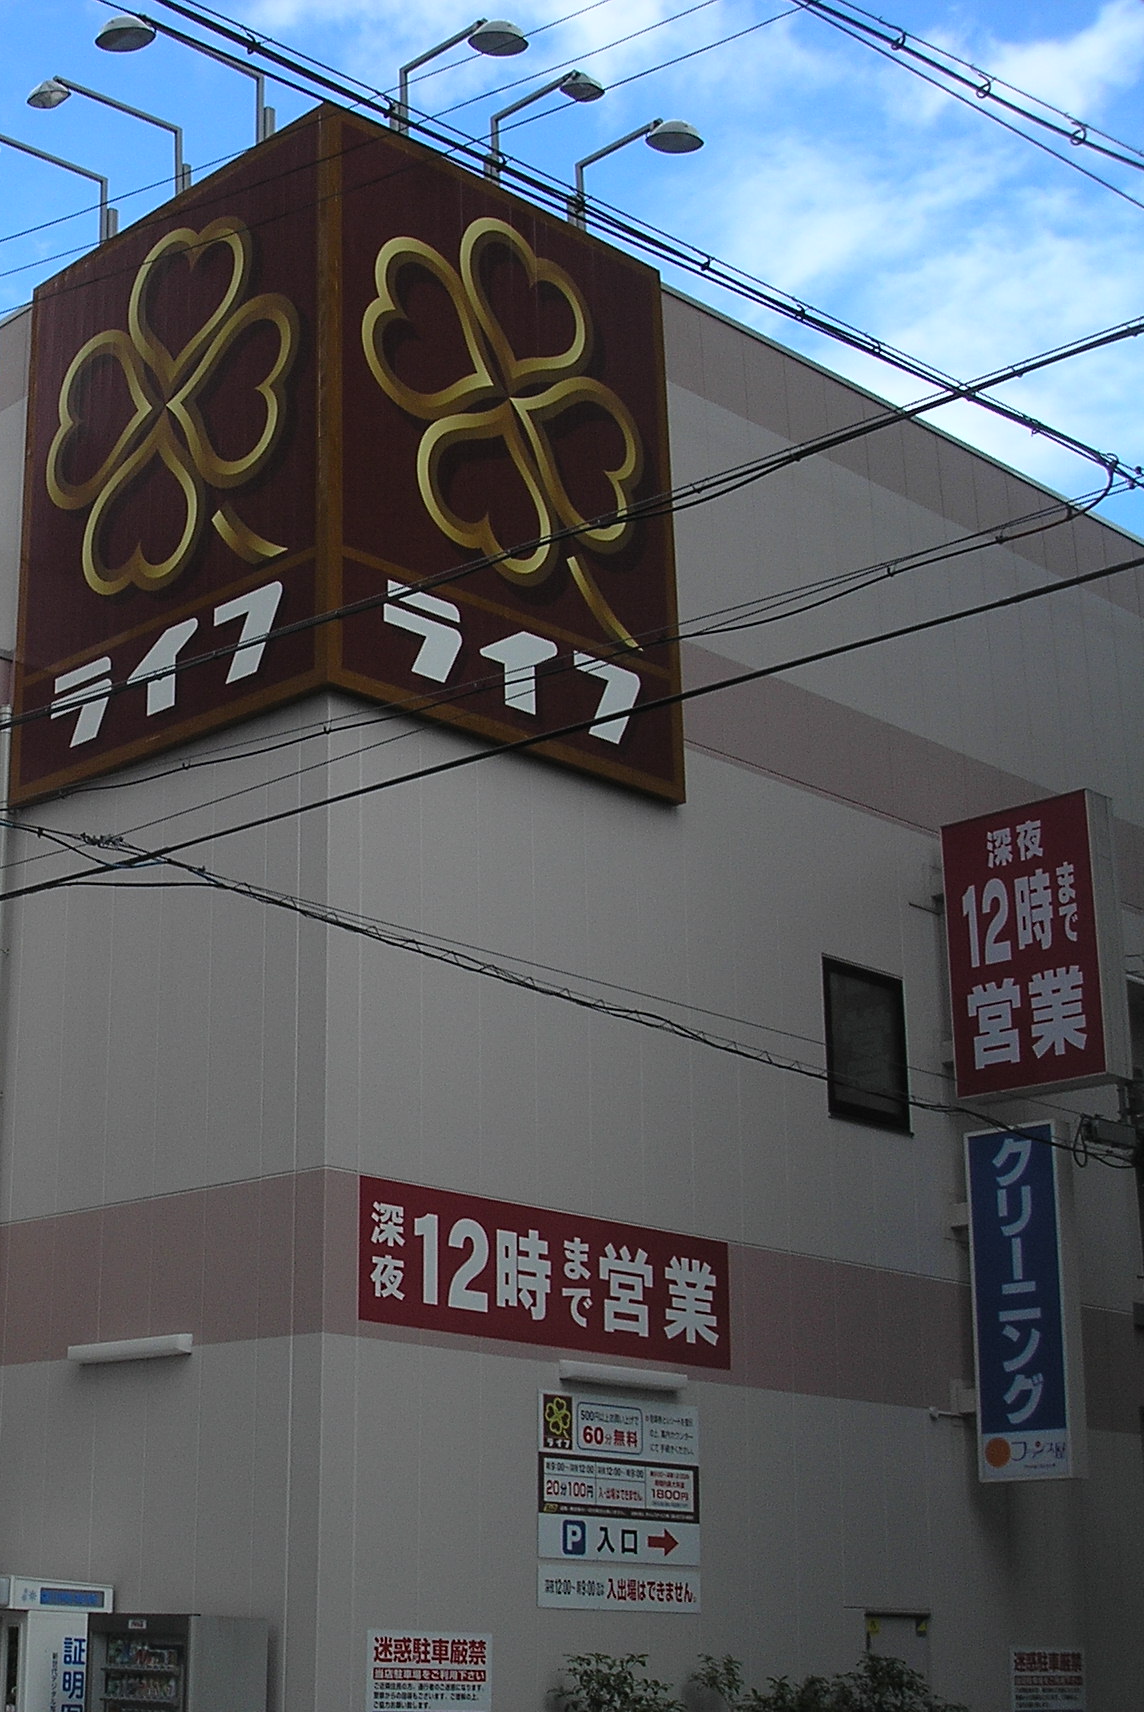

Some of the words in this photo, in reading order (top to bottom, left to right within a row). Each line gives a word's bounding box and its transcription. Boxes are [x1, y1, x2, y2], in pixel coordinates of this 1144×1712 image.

[51, 580, 283, 748] ライフ
[383, 579, 641, 745] ライフ
[987, 819, 1043, 868] 深夜
[962, 861, 1078, 968] 12時まで
[967, 965, 1087, 1070] 営業
[990, 1136, 1047, 1425] クリーニング
[545, 1438, 571, 1450] ライフ
[583, 1425, 638, 1447] 60分無料
[546, 1479, 593, 1498] 20分100円
[652, 1488, 689, 1501] 1800円
[566, 1524, 583, 1551] P
[597, 1526, 638, 1554] 入口
[374, 1637, 486, 1664] 迷惑駐車厳禁
[374, 1668, 485, 1681] 当店駐車場をご利用下さい
